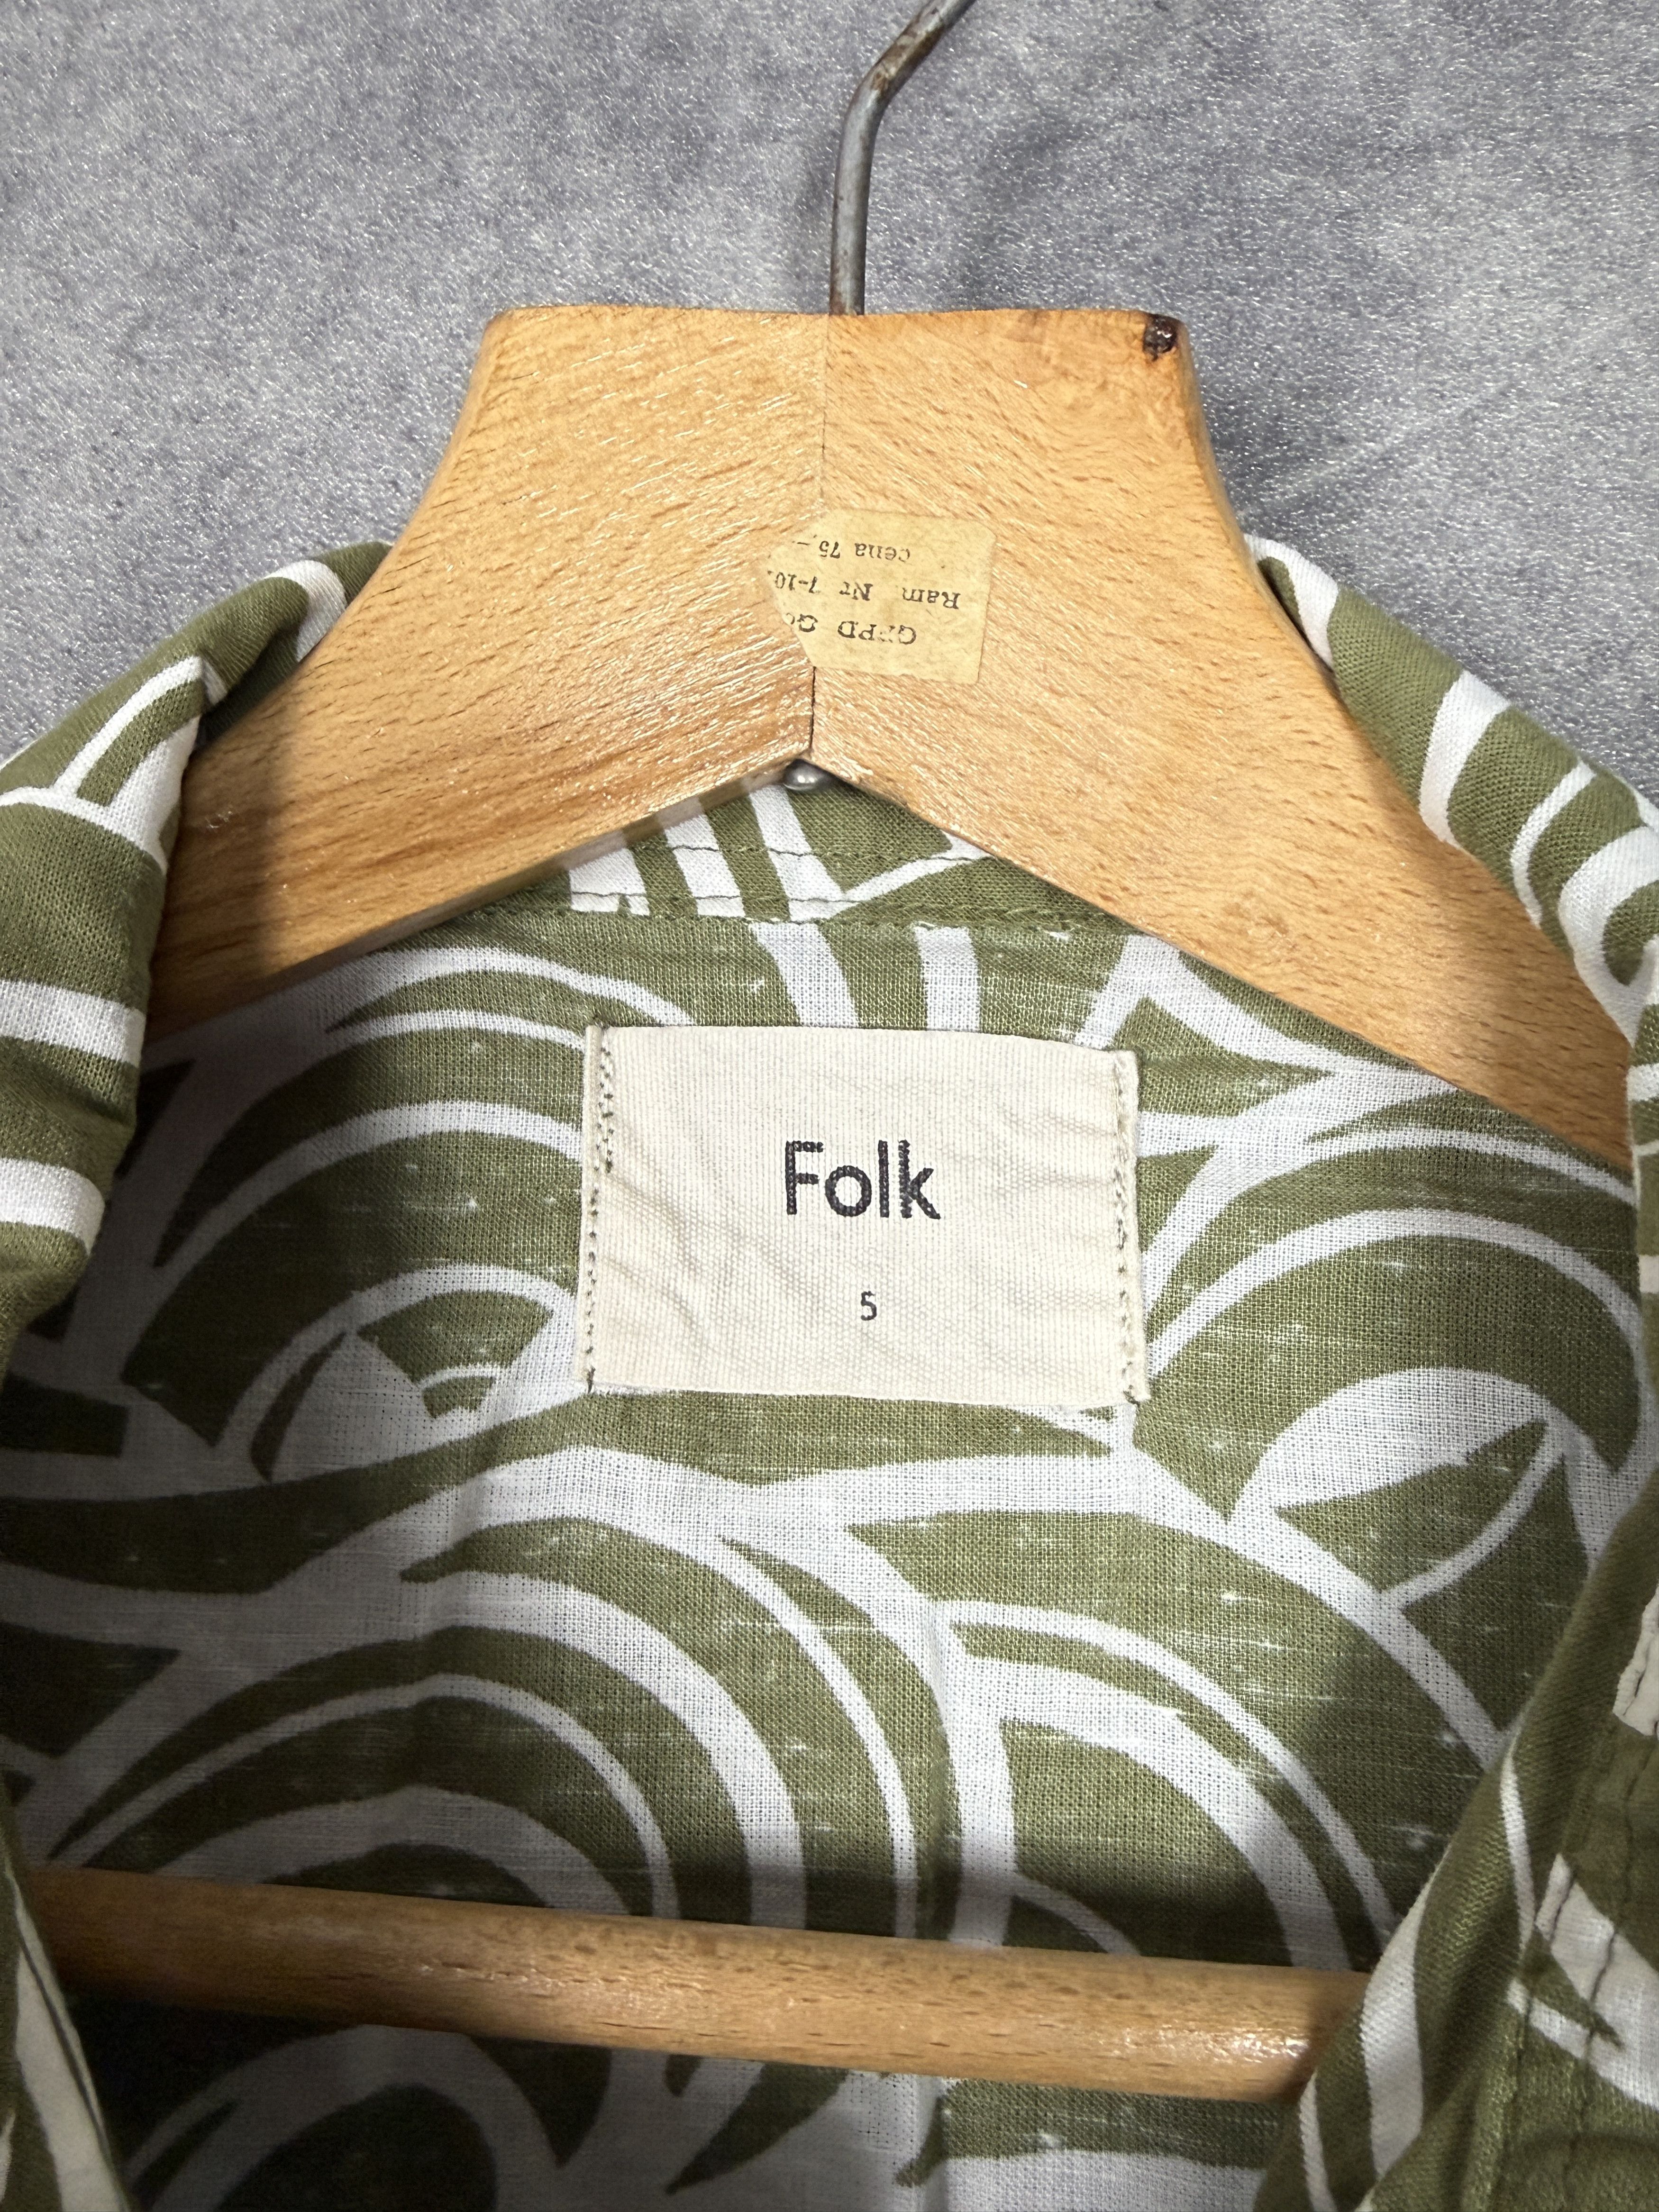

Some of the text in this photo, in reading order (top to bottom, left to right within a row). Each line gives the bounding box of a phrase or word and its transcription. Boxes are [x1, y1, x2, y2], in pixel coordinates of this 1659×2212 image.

[854, 542, 911, 562] cena
[839, 581, 874, 601] Nr
[785, 1139, 941, 1220] Folk
[861, 1291, 877, 1321] 5
